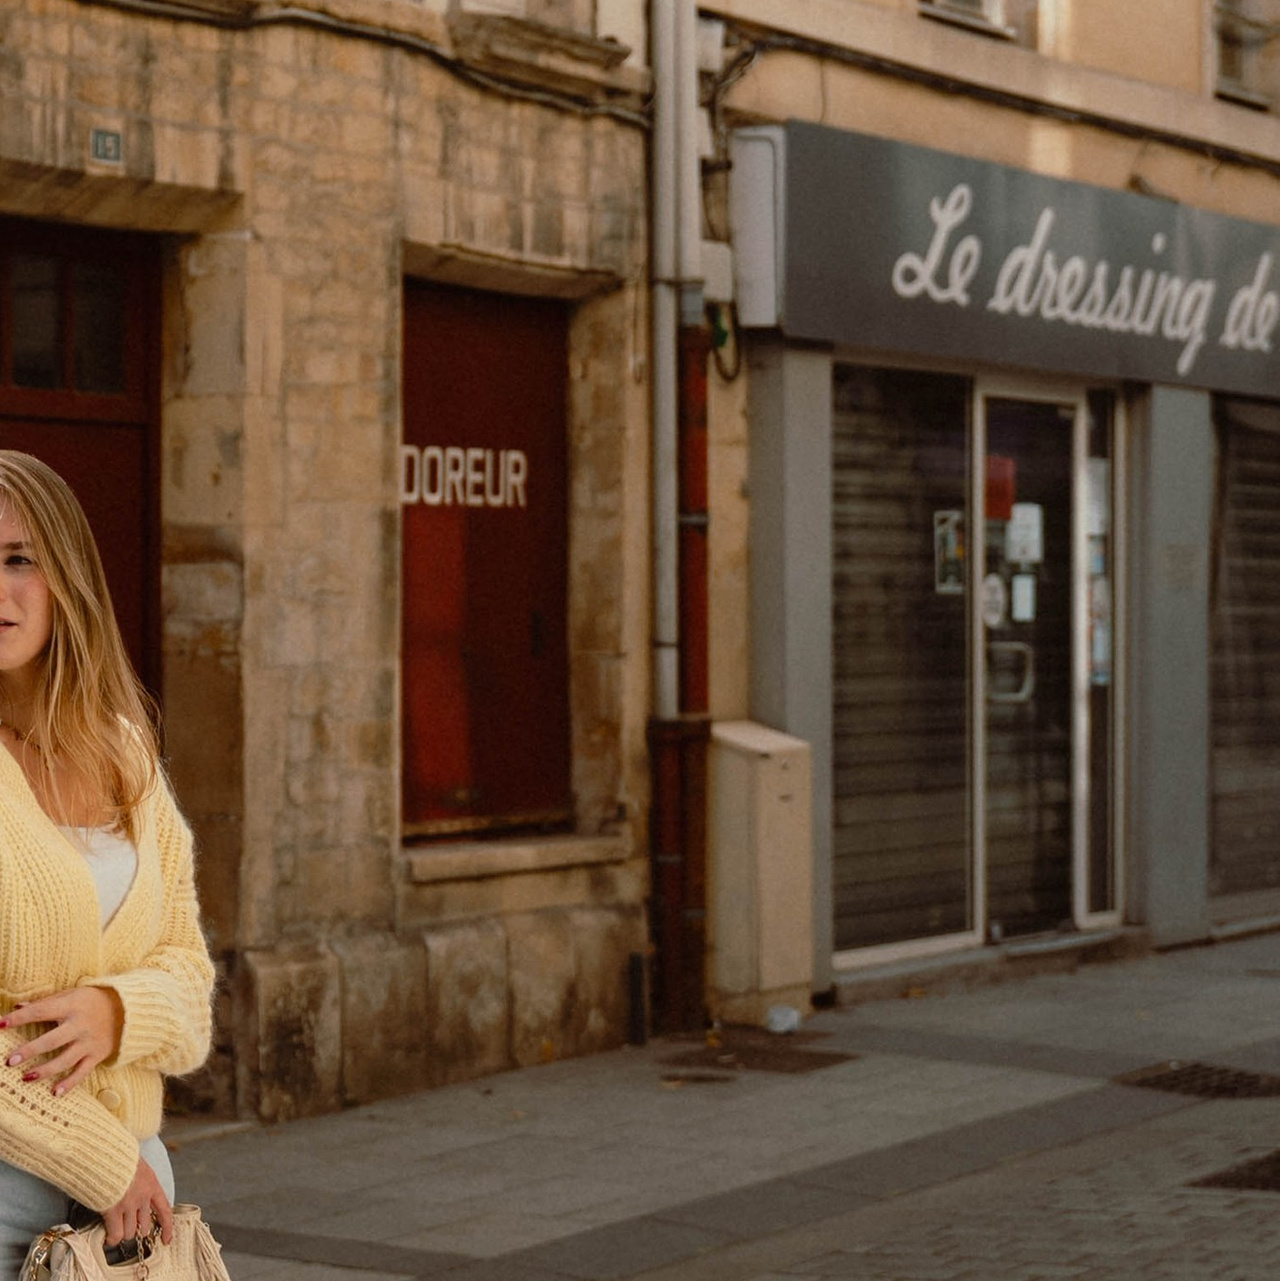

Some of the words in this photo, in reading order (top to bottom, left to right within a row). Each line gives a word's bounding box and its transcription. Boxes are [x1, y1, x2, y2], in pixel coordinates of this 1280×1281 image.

[892, 184, 981, 305] Le
[988, 207, 1215, 376] dressing
[401, 445, 528, 507] DOREUR
